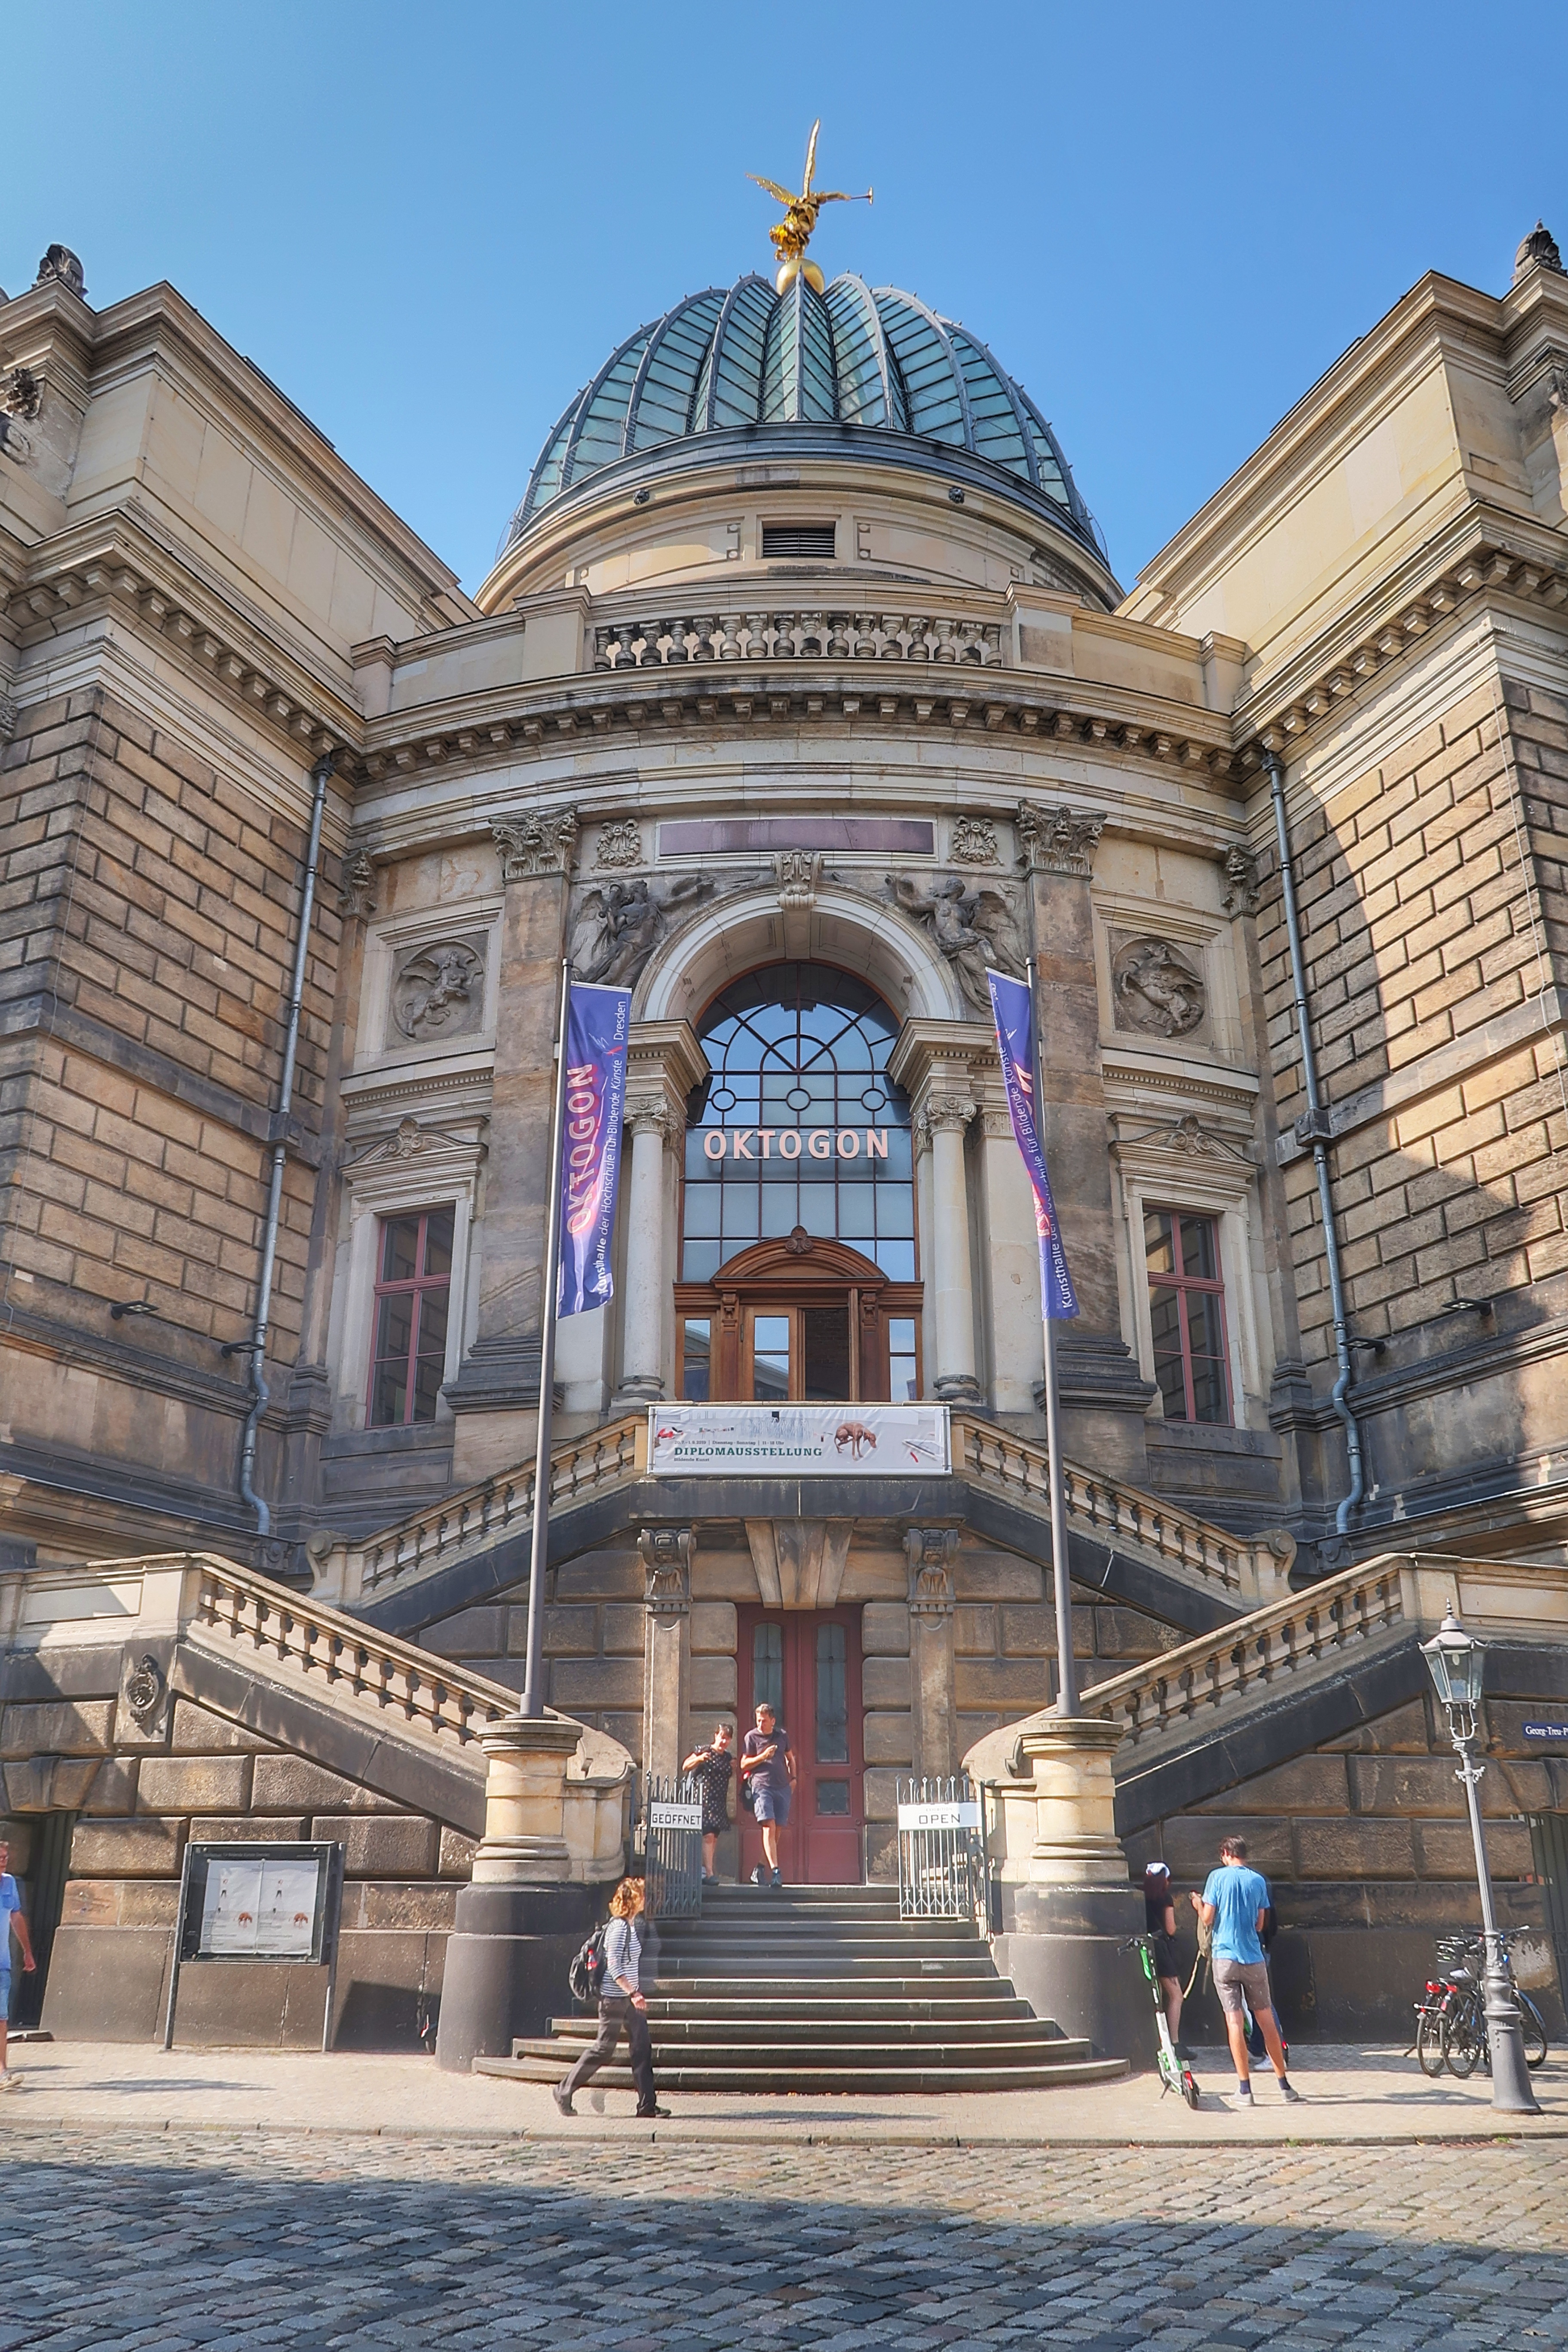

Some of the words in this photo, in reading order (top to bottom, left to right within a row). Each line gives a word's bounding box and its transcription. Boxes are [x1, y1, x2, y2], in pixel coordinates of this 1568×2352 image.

[613, 1001, 626, 1041] Dresden
[610, 1060, 622, 1090] Künste
[998, 1046, 1016, 1084] Künste
[606, 1092, 620, 1134] Bildende
[1010, 1087, 1033, 1135] Bildende
[567, 1064, 595, 1234] OKTOGON
[704, 1129, 888, 1160] OKTOGON
[1026, 1138, 1039, 1154] für
[601, 1155, 615, 1213] Hochschule
[599, 1216, 609, 1235] der
[593, 1238, 609, 1295] Kunsthalle
[1052, 1243, 1073, 1308] Kunsthalle
[674, 1447, 822, 1456] DIPLOMAUSSTELLUNG
[1525, 1726, 1568, 1736] Georg-Treu-P
[652, 1811, 701, 1825] GEÖFFNET
[919, 1813, 960, 1824] OPEN
